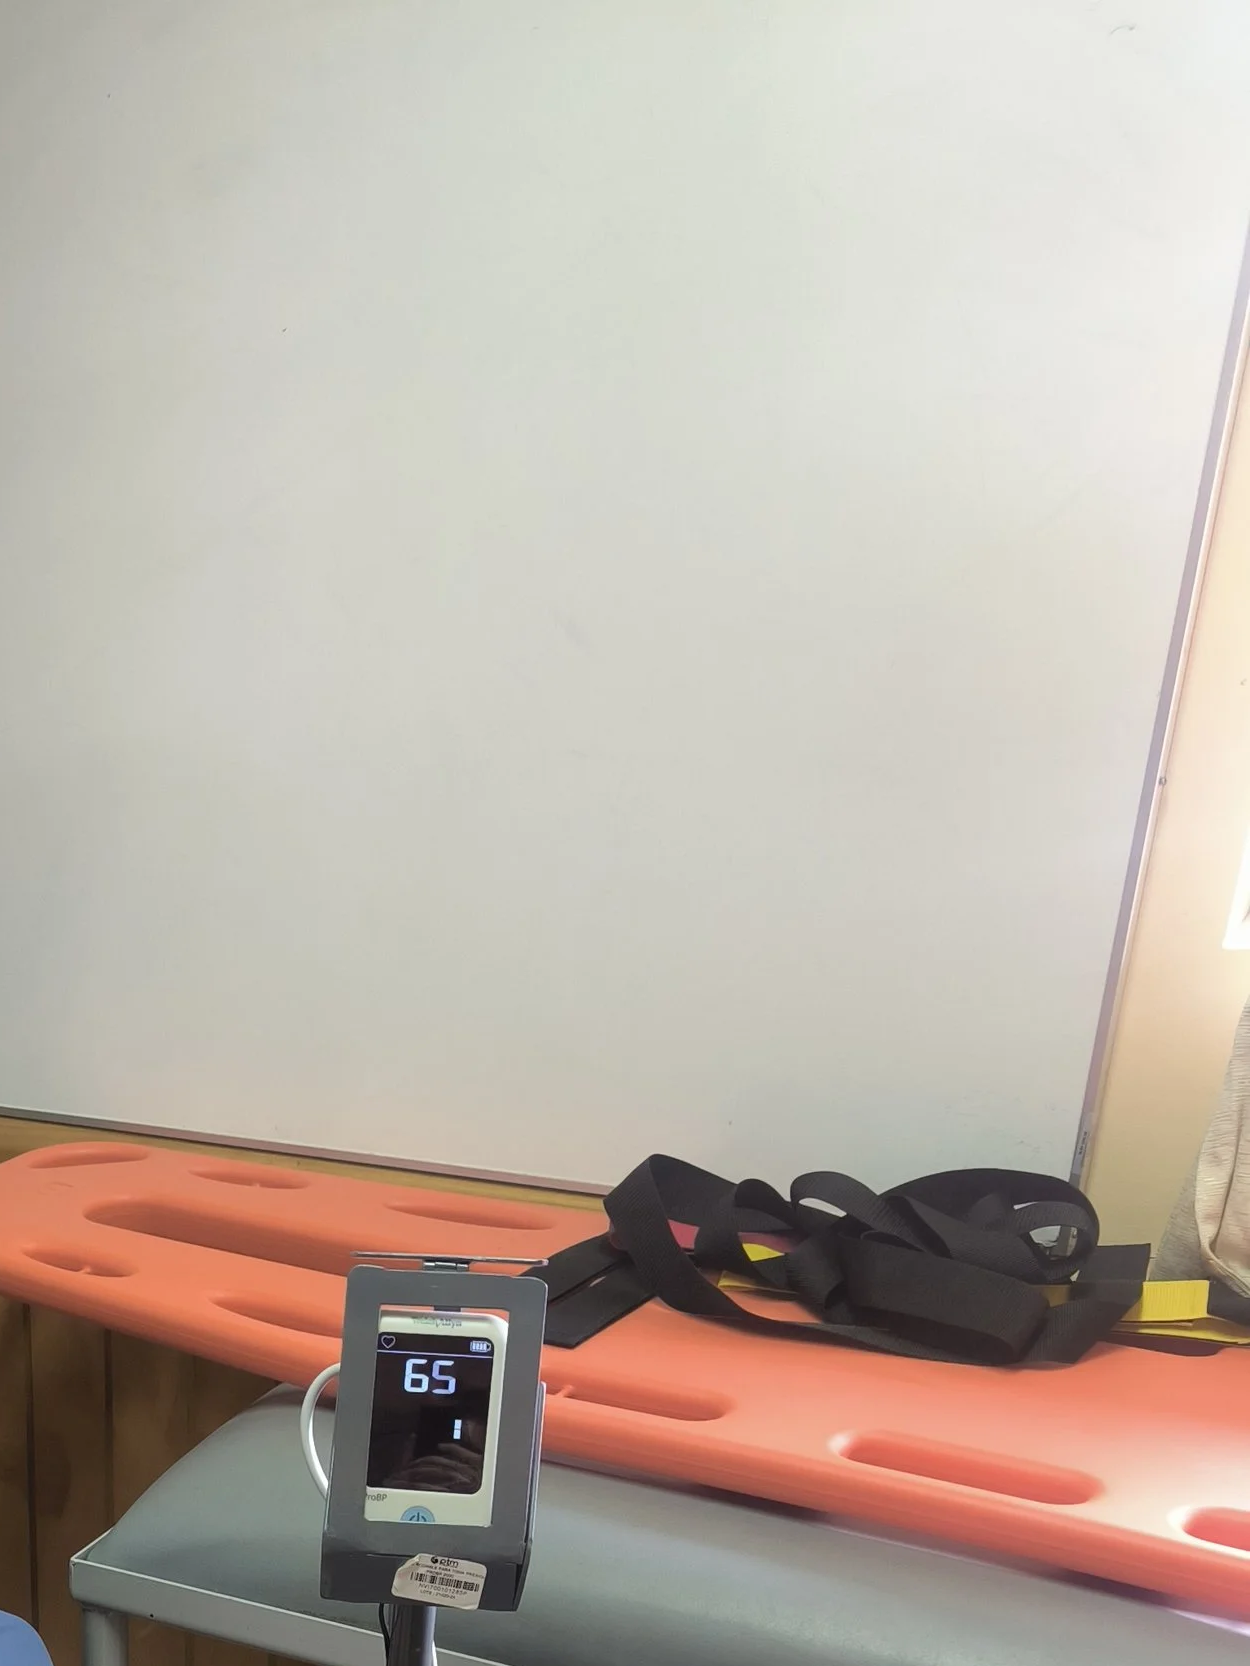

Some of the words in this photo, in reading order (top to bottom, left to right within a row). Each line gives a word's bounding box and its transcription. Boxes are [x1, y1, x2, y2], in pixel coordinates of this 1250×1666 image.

[404, 1358, 456, 1395] 65
[453, 1419, 462, 1440] 1
[366, 1493, 388, 1502] roBP
